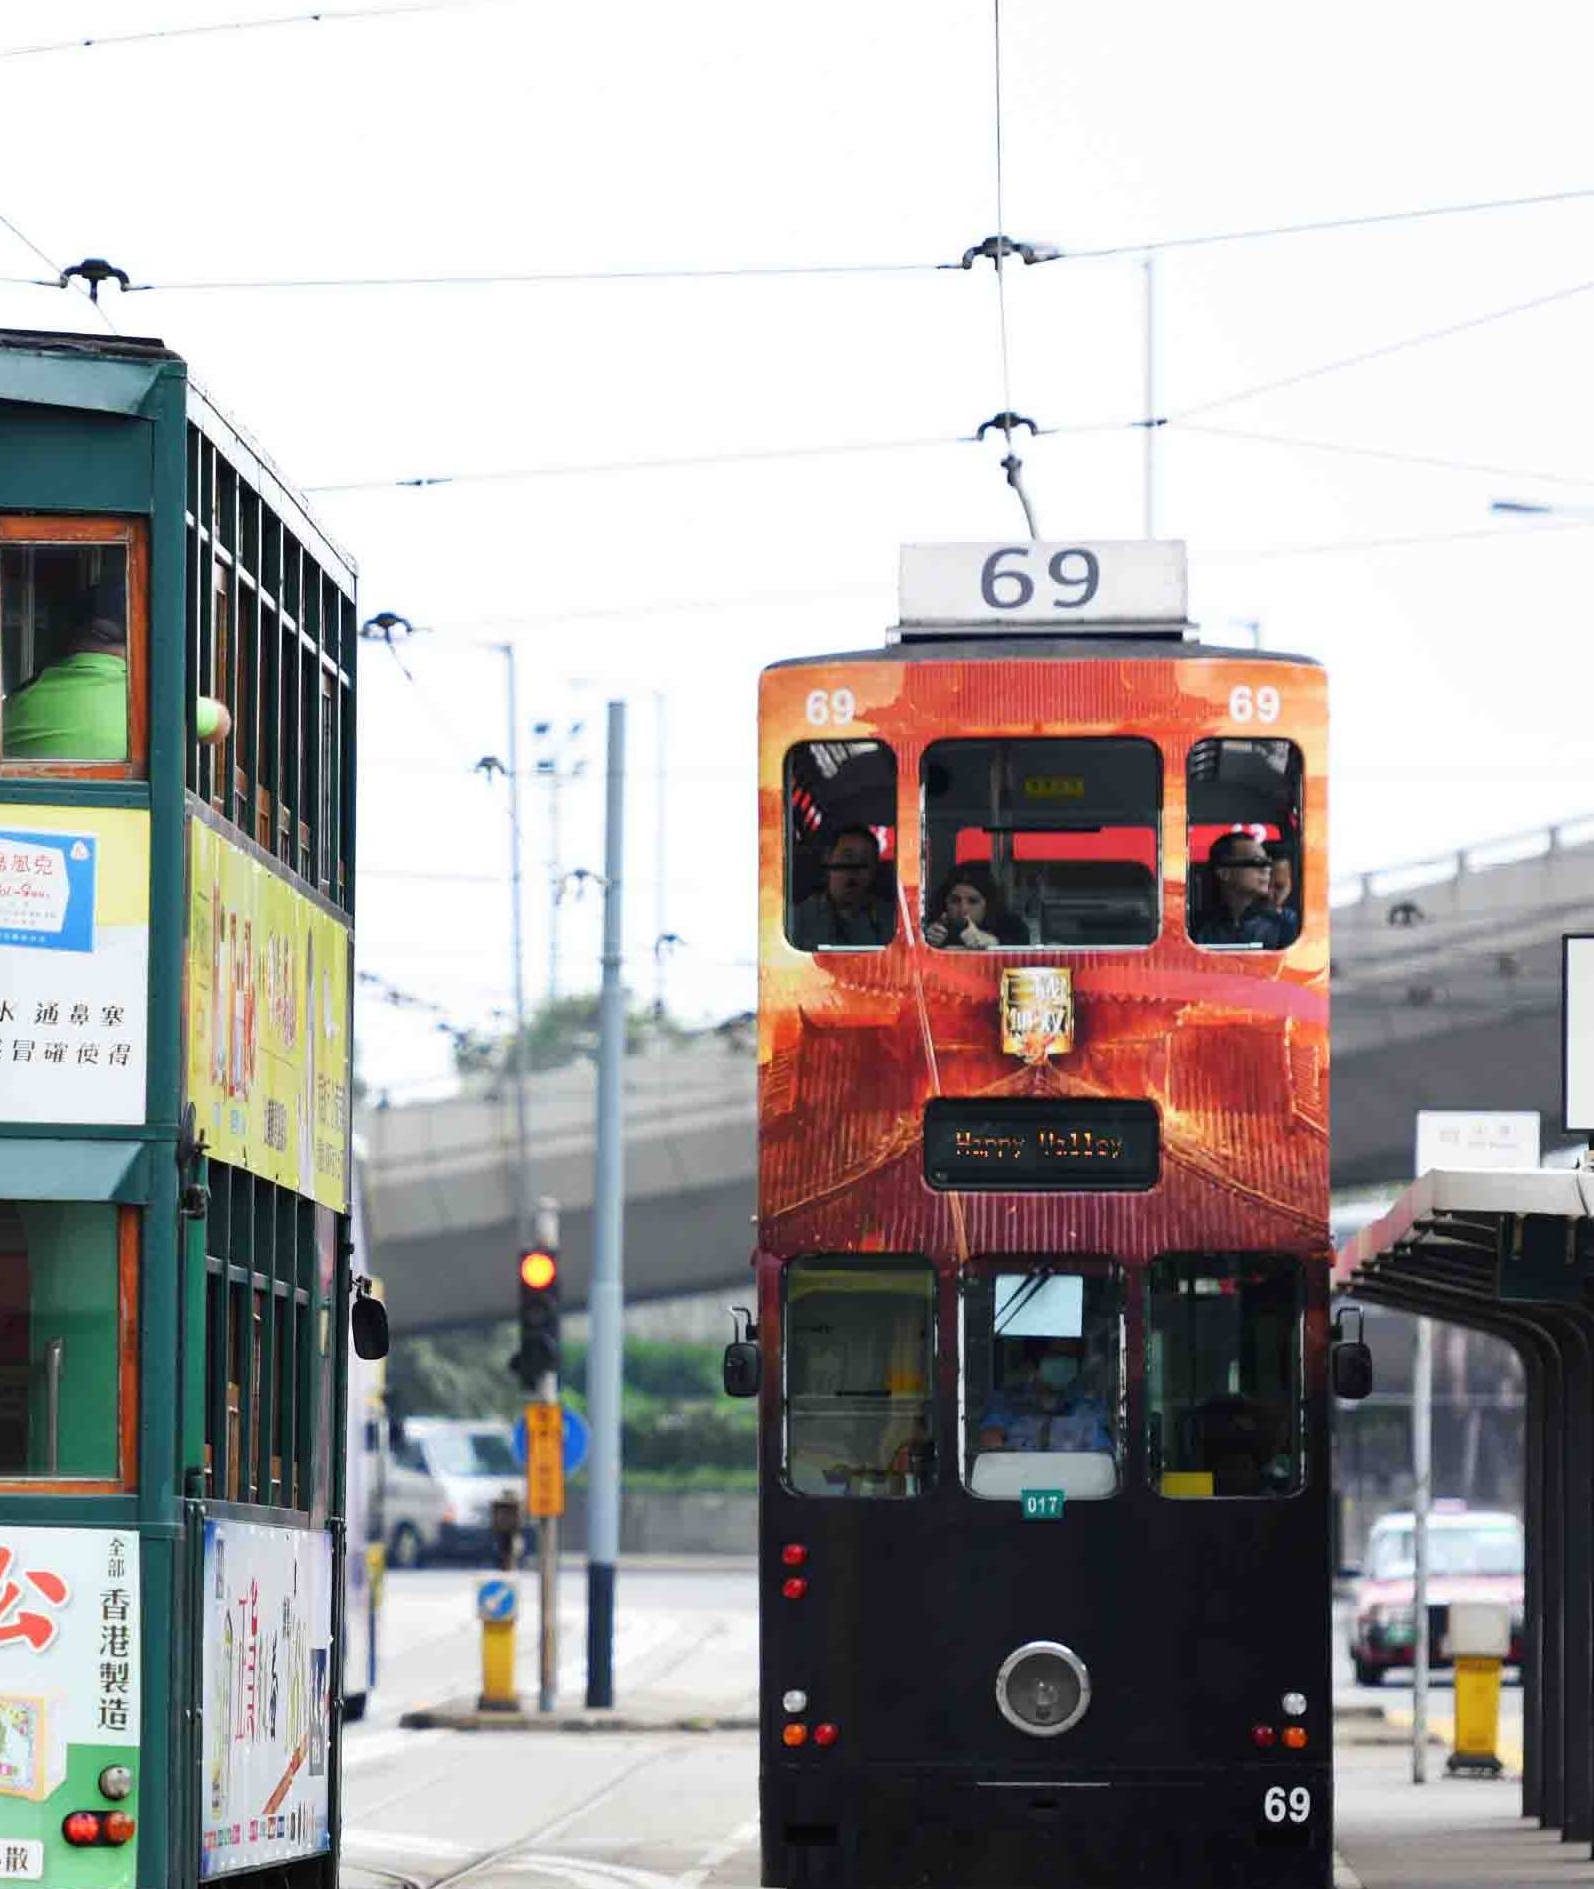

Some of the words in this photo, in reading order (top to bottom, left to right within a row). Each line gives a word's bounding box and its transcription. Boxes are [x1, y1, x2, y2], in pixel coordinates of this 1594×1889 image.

[981, 547, 1100, 610] 69
[805, 688, 856, 726] 69
[1229, 685, 1281, 723] 69
[33, 1001, 126, 1028] 通鼻塞
[955, 1130, 1026, 1159] Happy
[1037, 1130, 1124, 1159] Valley
[1027, 1495, 1058, 1513] 017
[107, 1537, 125, 1578] 全部
[98, 1587, 131, 1732] 香港製造
[1264, 1786, 1311, 1823] 69
